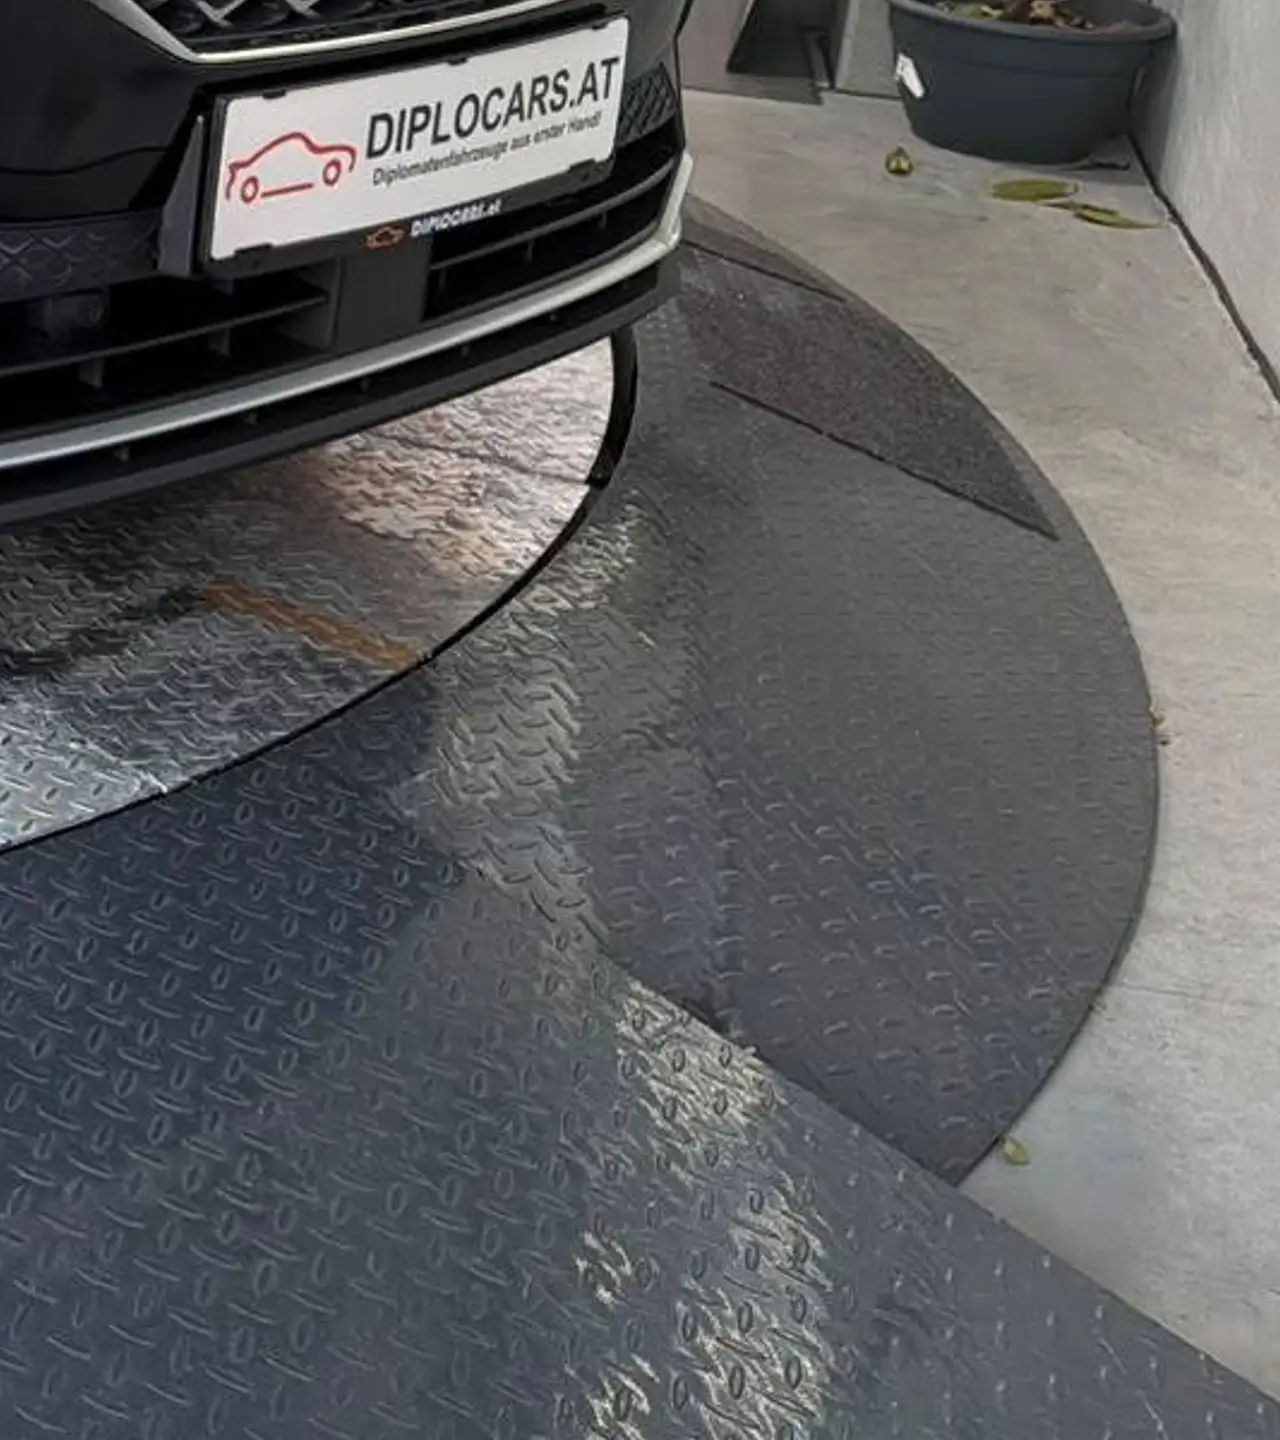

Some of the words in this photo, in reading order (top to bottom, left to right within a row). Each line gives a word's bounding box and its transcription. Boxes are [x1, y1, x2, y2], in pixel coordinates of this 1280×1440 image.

[364, 57, 621, 159] DIPLOCARS.AT
[372, 139, 508, 187] Diplomatenfahrzeuge
[510, 134, 531, 151] aus
